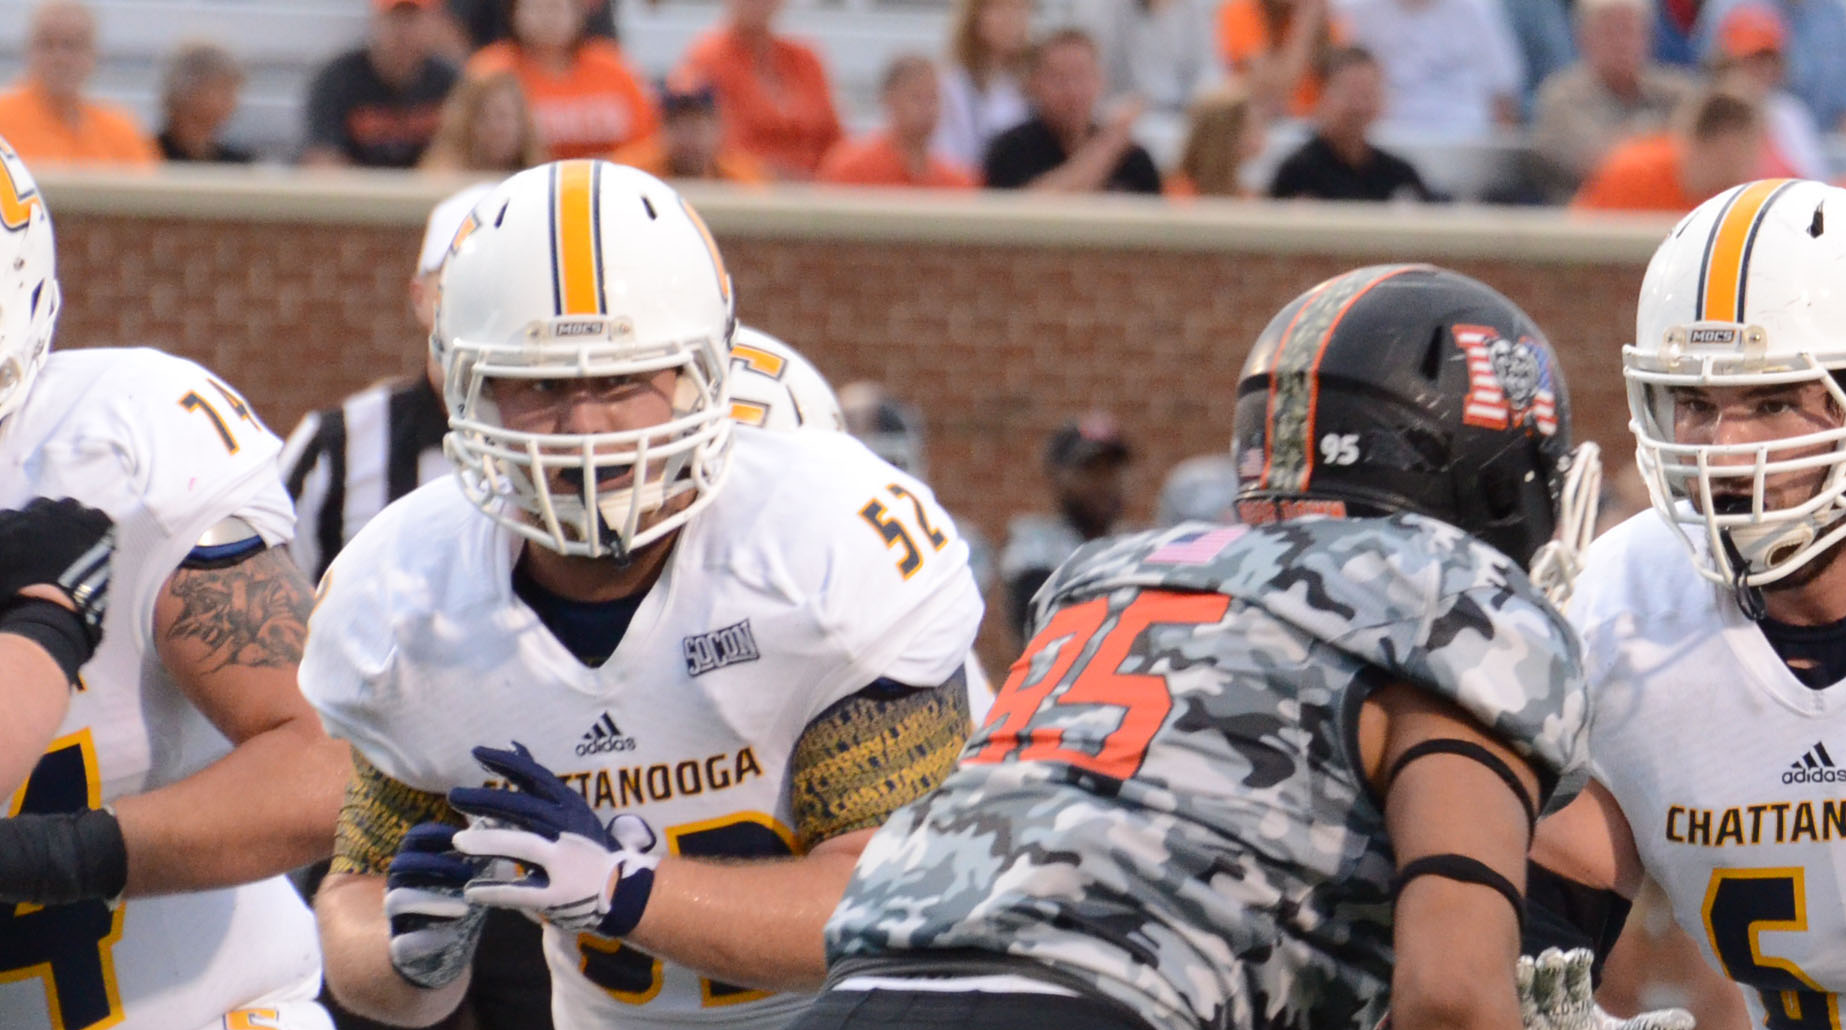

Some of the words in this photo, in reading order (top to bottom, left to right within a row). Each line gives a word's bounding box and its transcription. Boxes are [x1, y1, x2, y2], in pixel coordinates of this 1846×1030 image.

[1691, 330, 1735, 343] MOCS
[1320, 432, 1360, 466] 95
[857, 482, 948, 581] 52
[575, 736, 636, 757] adidas
[482, 745, 764, 810] TANOOGA
